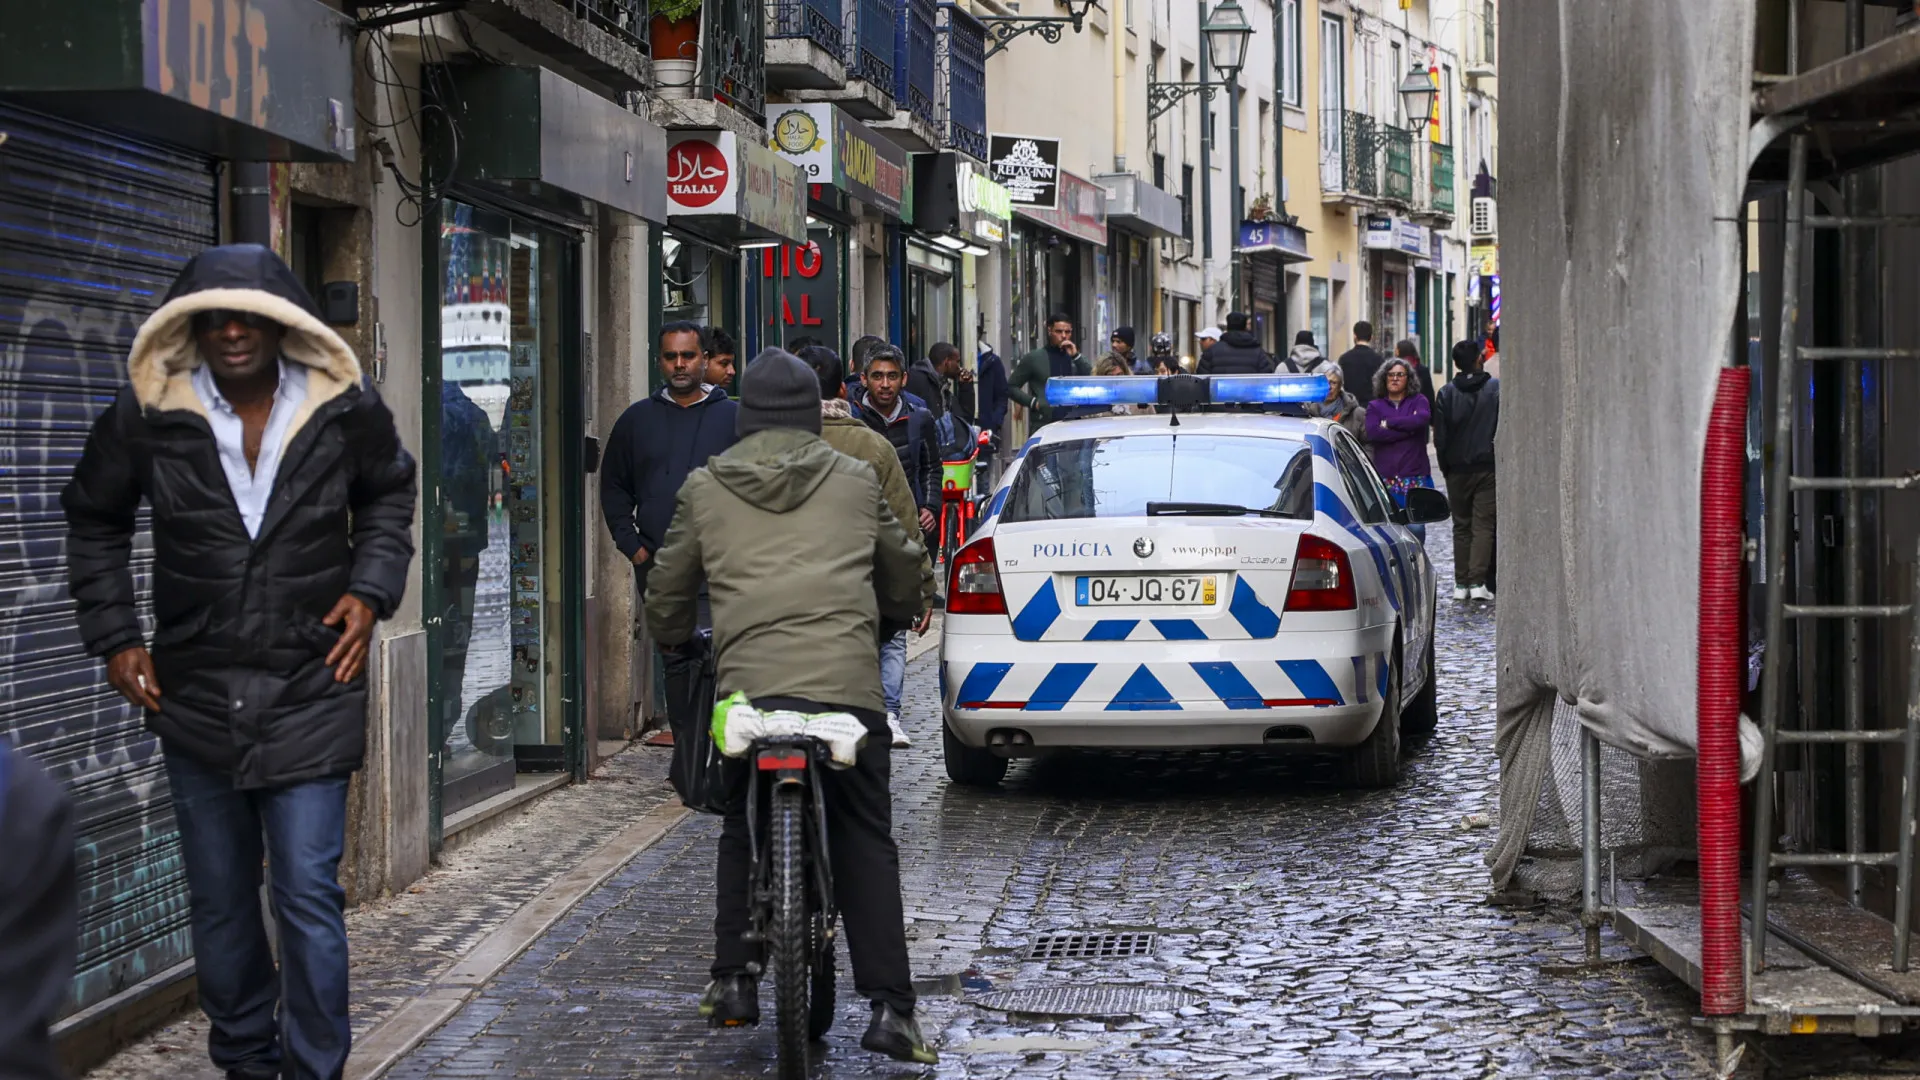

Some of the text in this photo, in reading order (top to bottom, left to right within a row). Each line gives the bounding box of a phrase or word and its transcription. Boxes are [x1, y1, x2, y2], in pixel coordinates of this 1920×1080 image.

[845, 130, 876, 189] ZAMZAM
[997, 164, 1053, 179] RELAX-INN
[673, 184, 718, 194] HALAL
[1248, 229, 1264, 244] 45
[1033, 539, 1113, 558] POLÍCIA
[1204, 593, 1214, 601] 08
